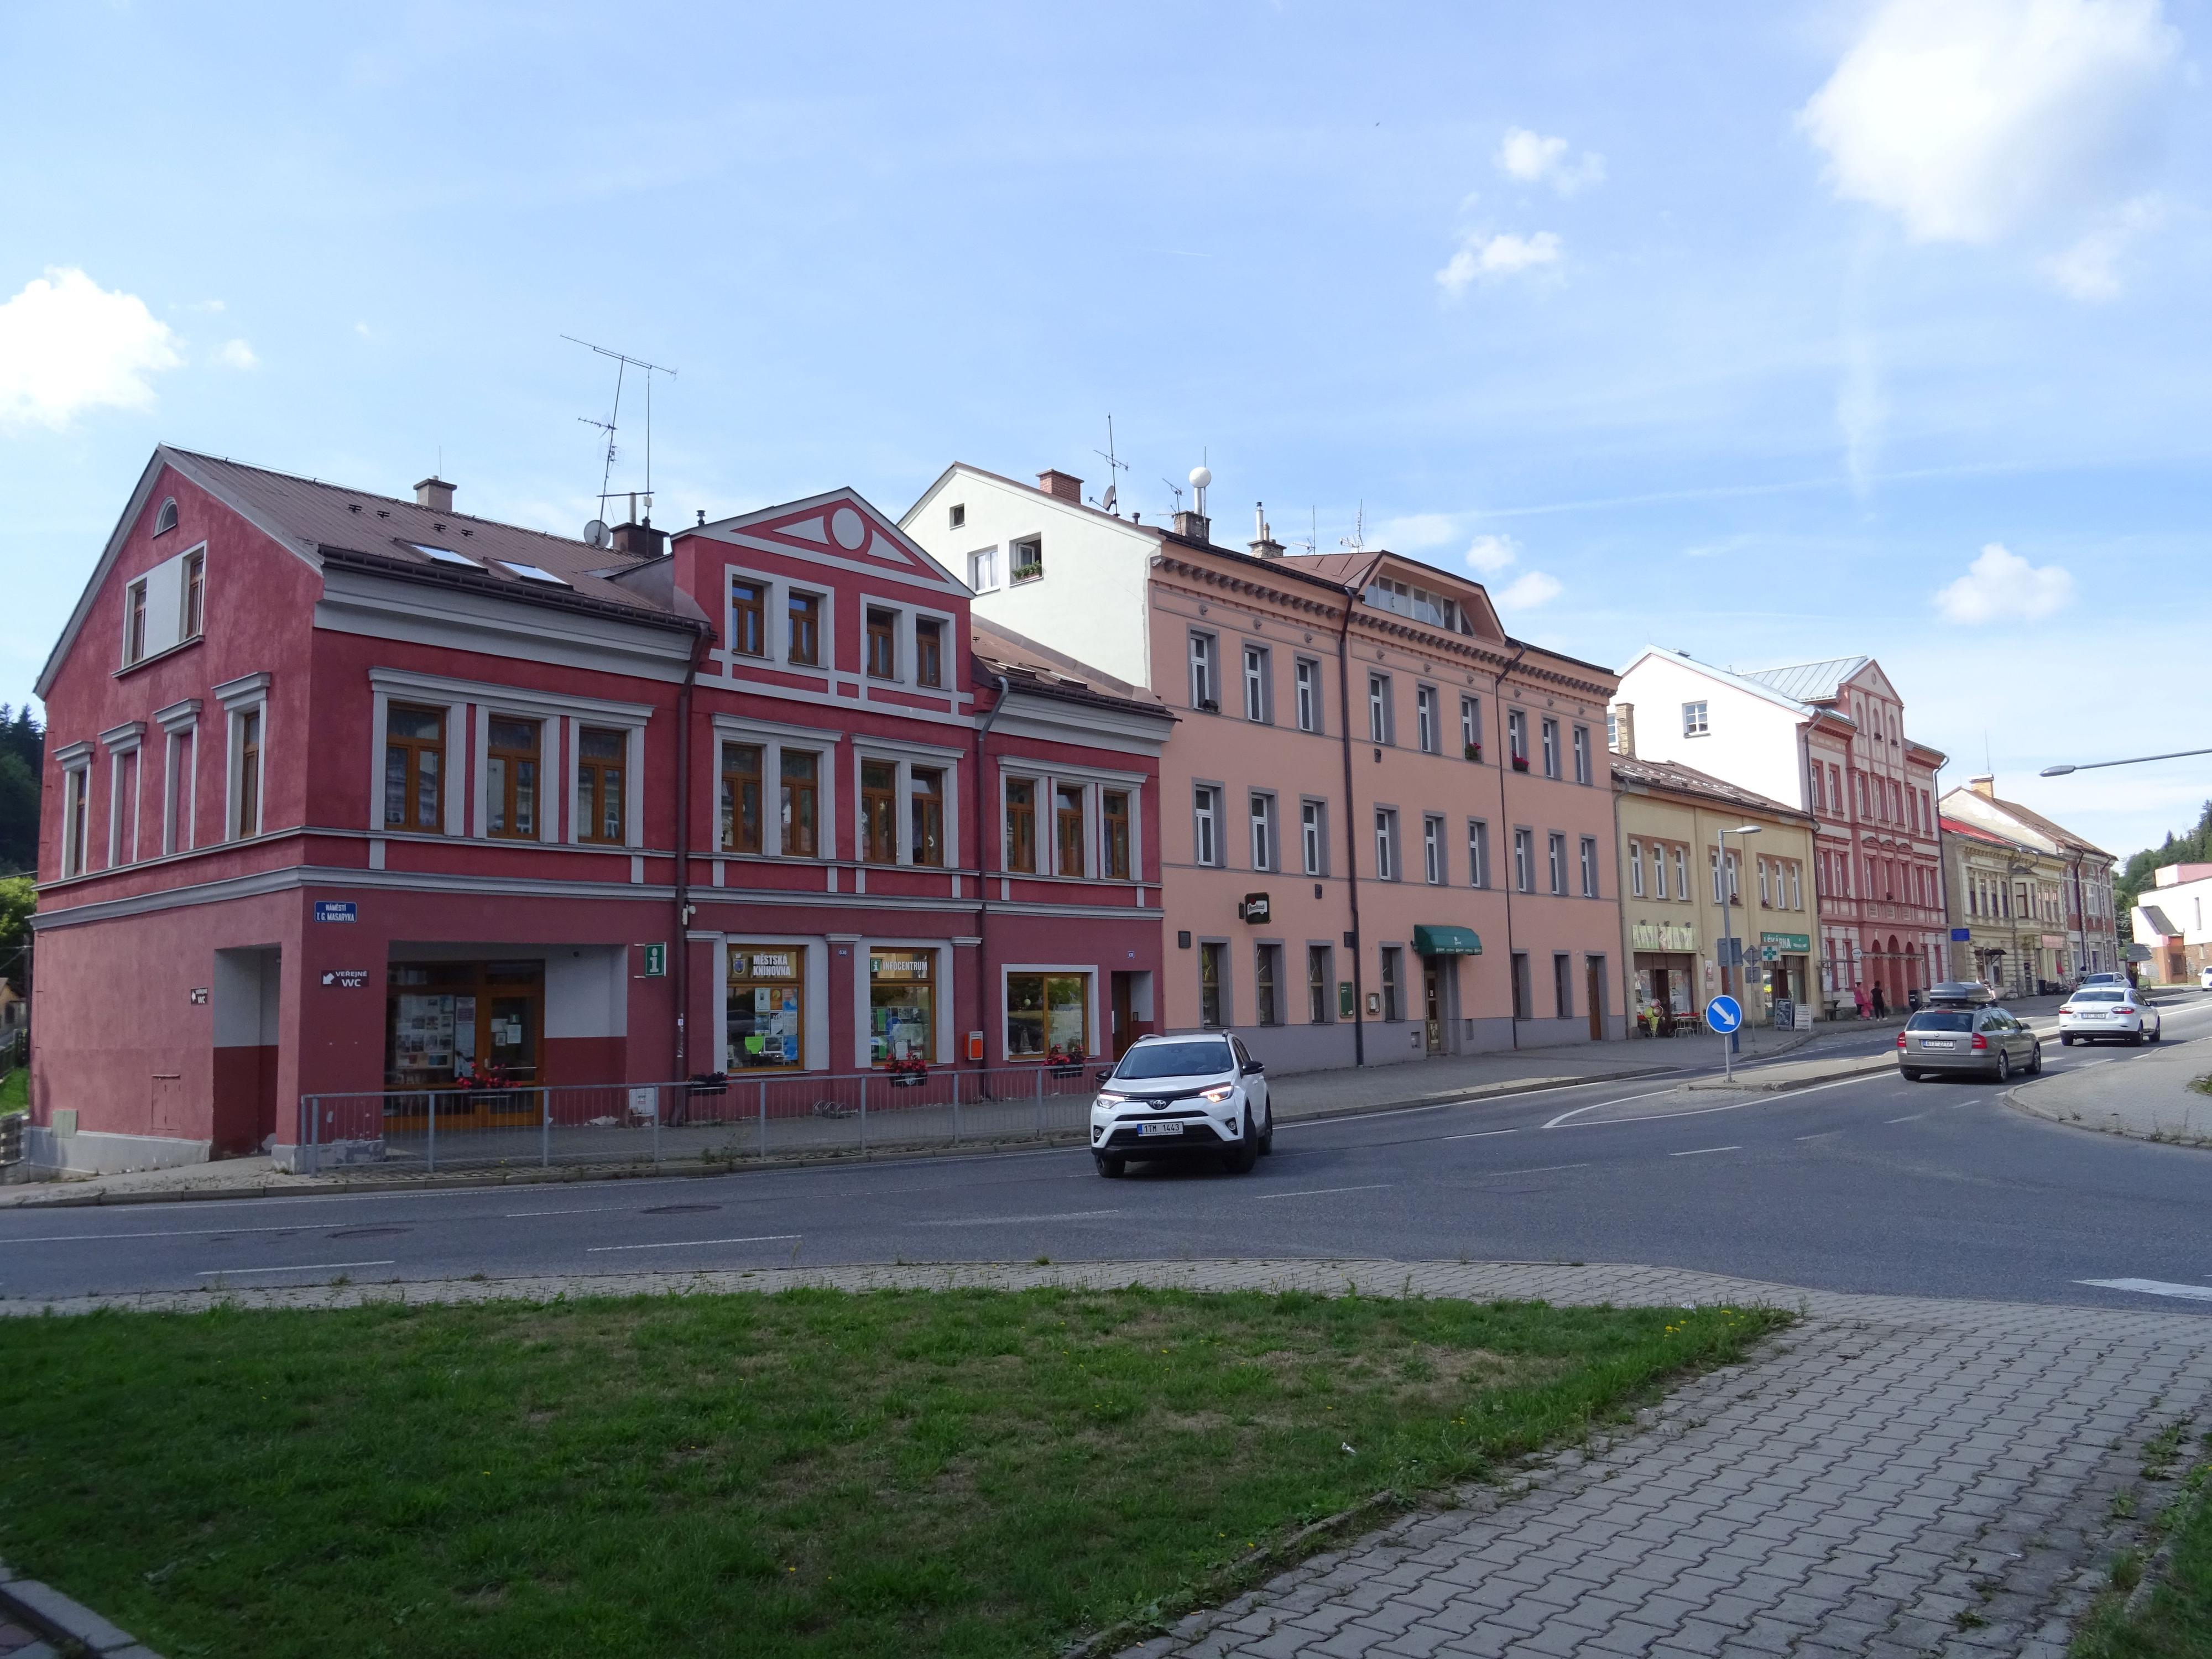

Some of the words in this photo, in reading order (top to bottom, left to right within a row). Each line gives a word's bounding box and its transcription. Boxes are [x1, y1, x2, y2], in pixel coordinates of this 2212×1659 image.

[325, 903, 346, 912] NÁMĚSTÍ
[316, 912, 320, 921] T.
[321, 912, 326, 921] G.
[327, 913, 354, 922] MASARYKA
[753, 953, 787, 965] MĚSTSKÁ
[753, 966, 791, 976] KNIHOVNA
[883, 961, 928, 971] INFOCENTRUM
[341, 979, 361, 987] WC
